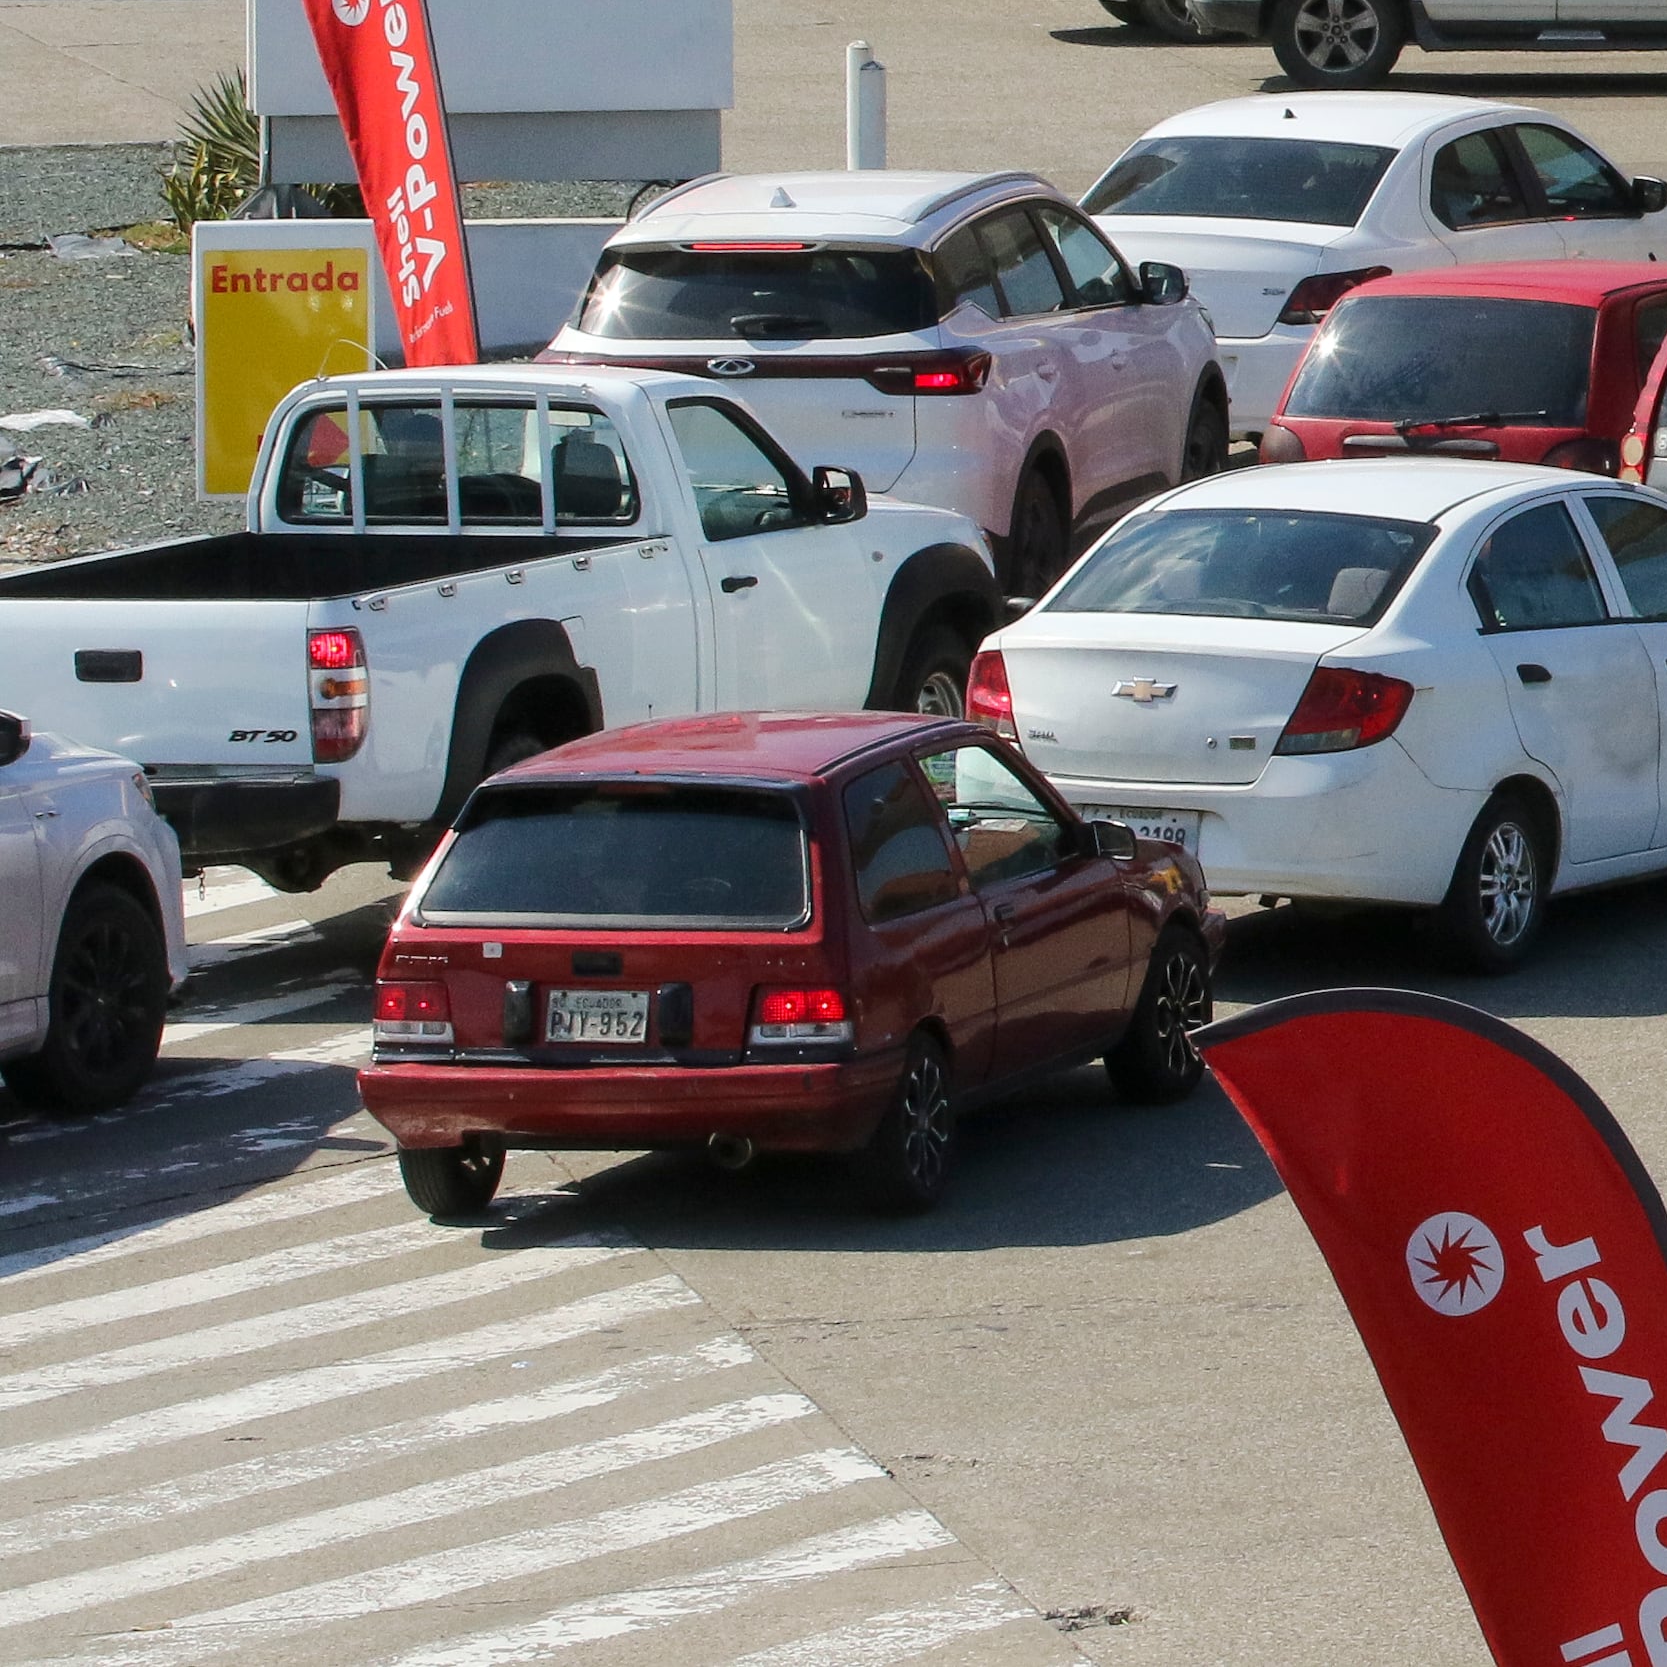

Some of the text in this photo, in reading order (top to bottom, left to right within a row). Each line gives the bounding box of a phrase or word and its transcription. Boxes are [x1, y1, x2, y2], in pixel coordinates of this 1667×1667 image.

[386, 185, 422, 309] Shell
[211, 264, 361, 296] Entrada
[229, 730, 298, 743] BT 50
